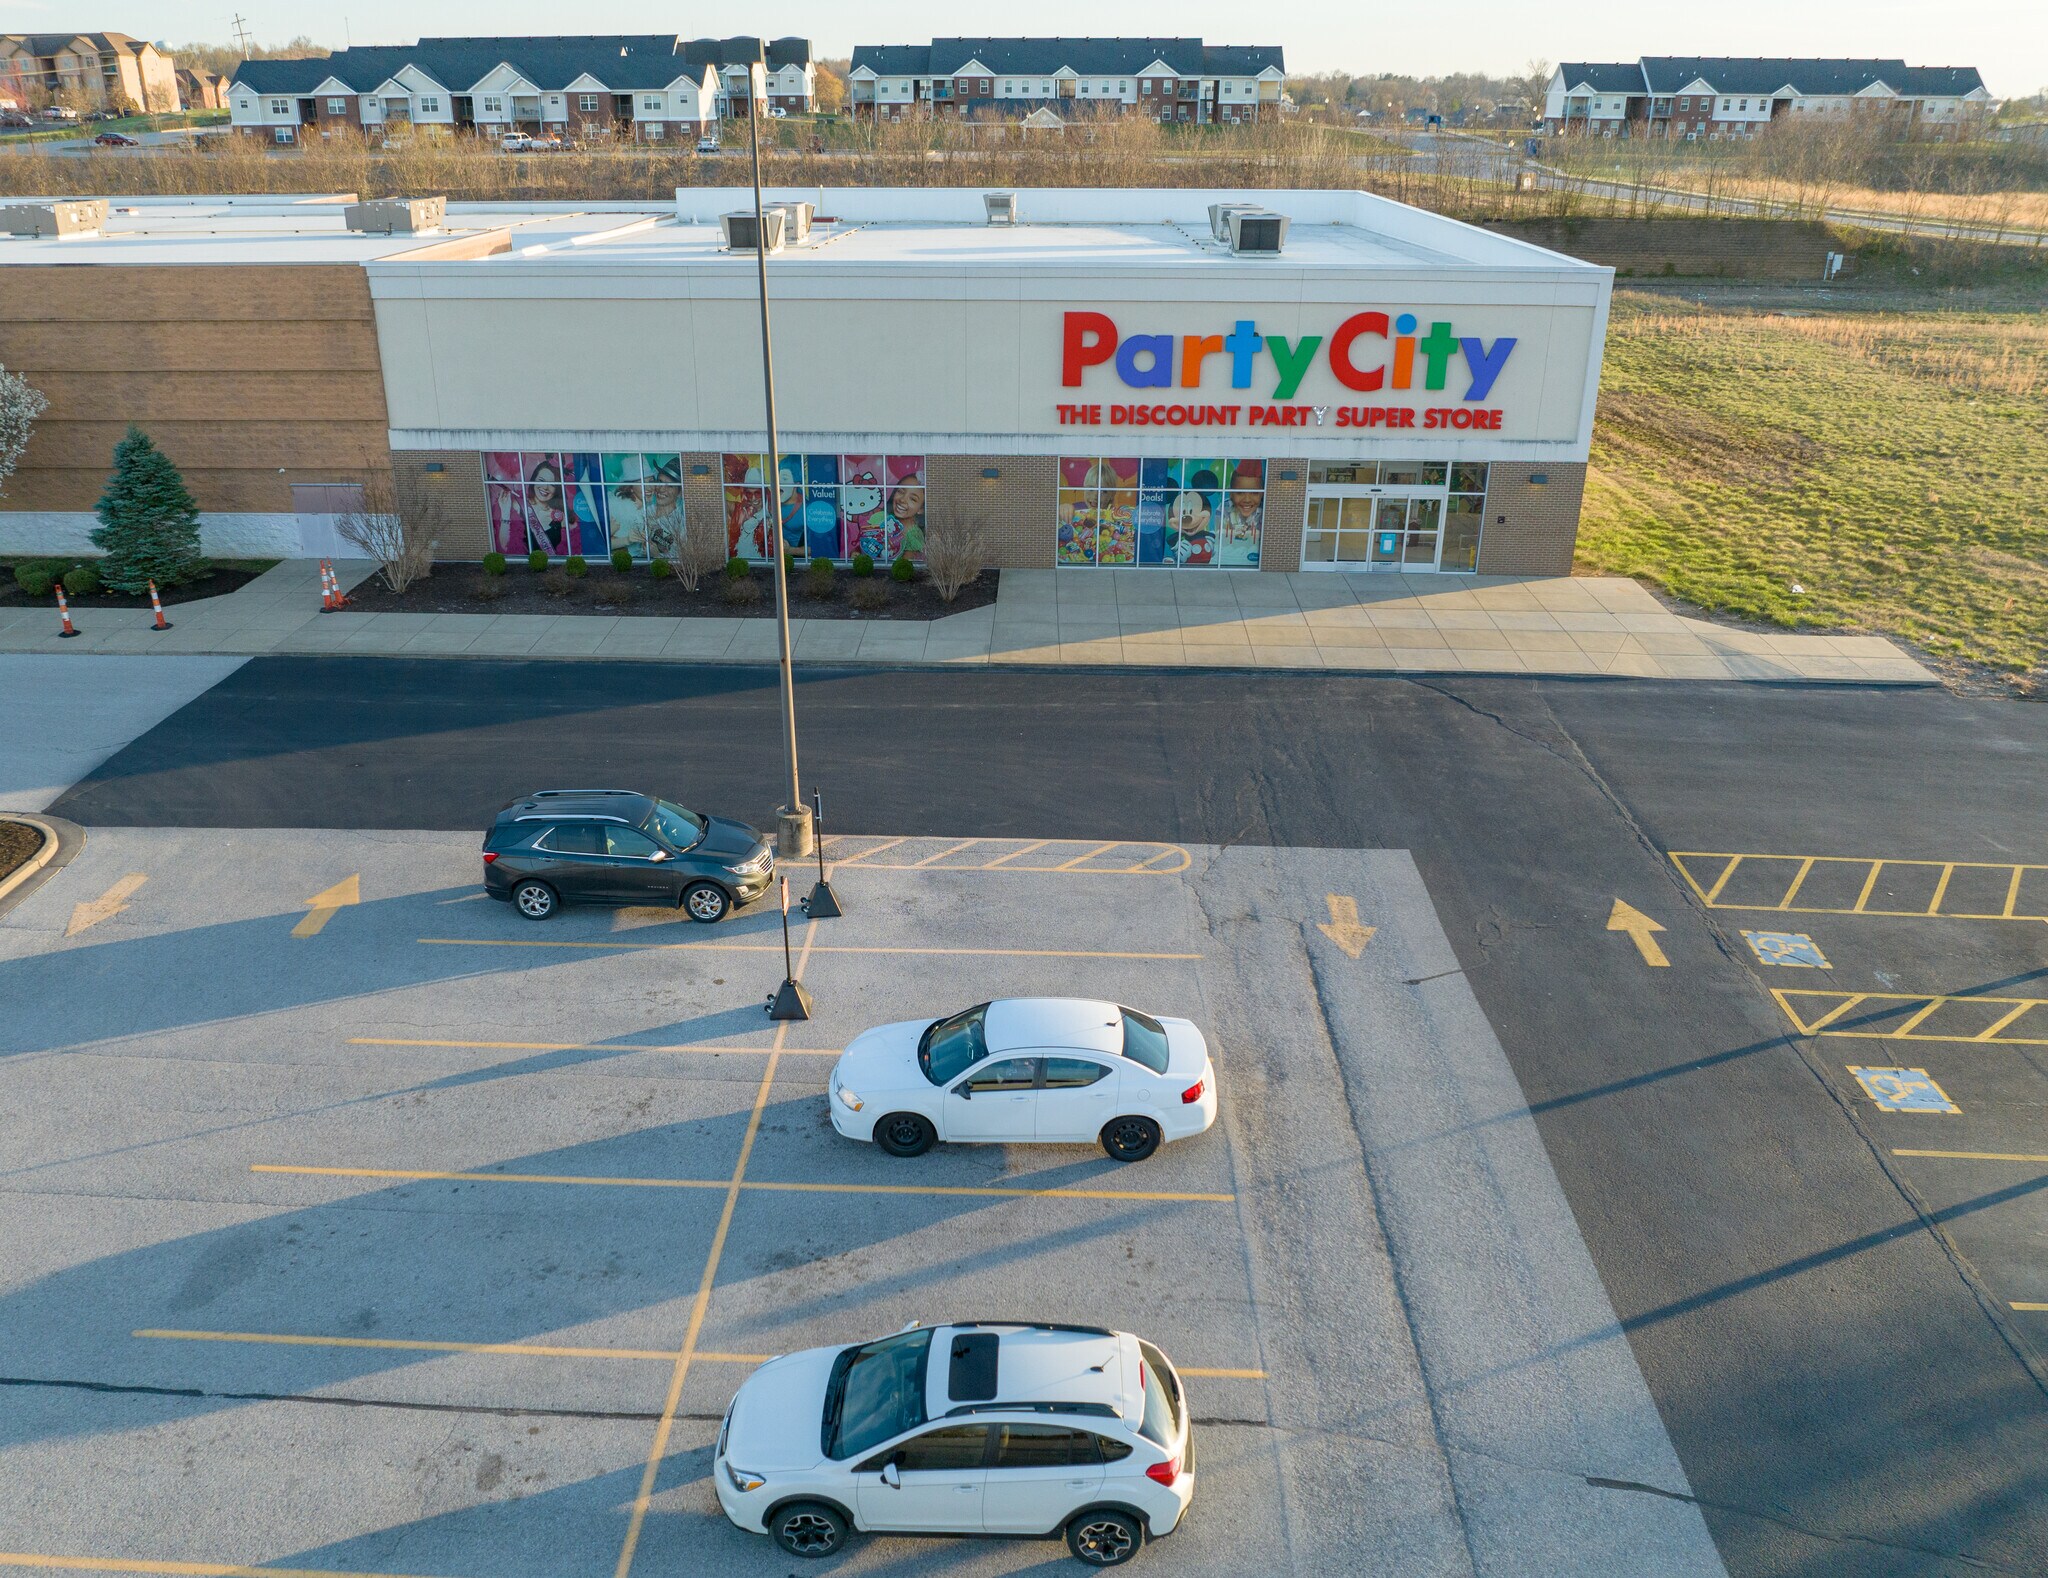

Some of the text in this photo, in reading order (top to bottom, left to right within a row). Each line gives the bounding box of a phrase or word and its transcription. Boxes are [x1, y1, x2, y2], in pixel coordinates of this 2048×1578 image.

[1057, 405, 1503, 430] THE DISCOUNT PARTY SUPER STORE
[812, 489, 835, 498] Value!
[1140, 492, 1163, 501] Deals!
